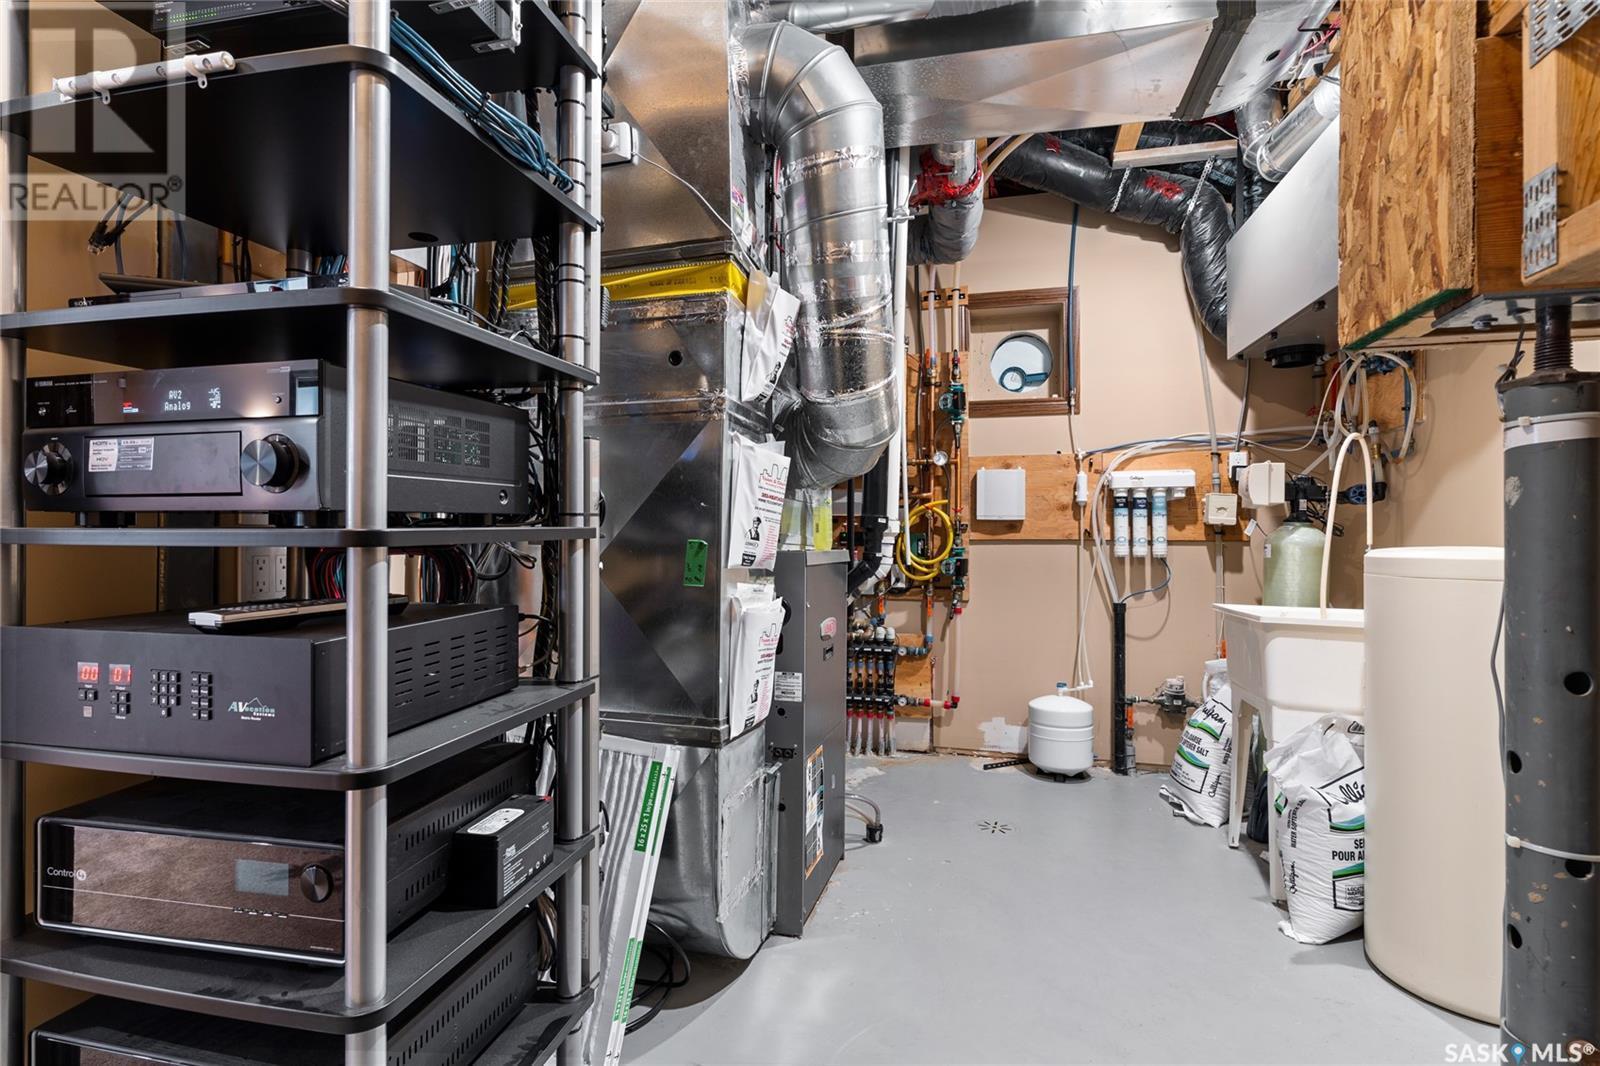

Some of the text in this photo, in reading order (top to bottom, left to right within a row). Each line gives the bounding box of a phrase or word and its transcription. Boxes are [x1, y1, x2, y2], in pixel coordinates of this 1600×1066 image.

[168, 390, 182, 400] AV2
[164, 402, 191, 411] Analog
[81, 666, 98, 681] 00
[113, 667, 131, 682] 01
[1196, 746, 1210, 757] SALT
[640, 823, 648, 832] 25
[1332, 850, 1356, 861] POUR
